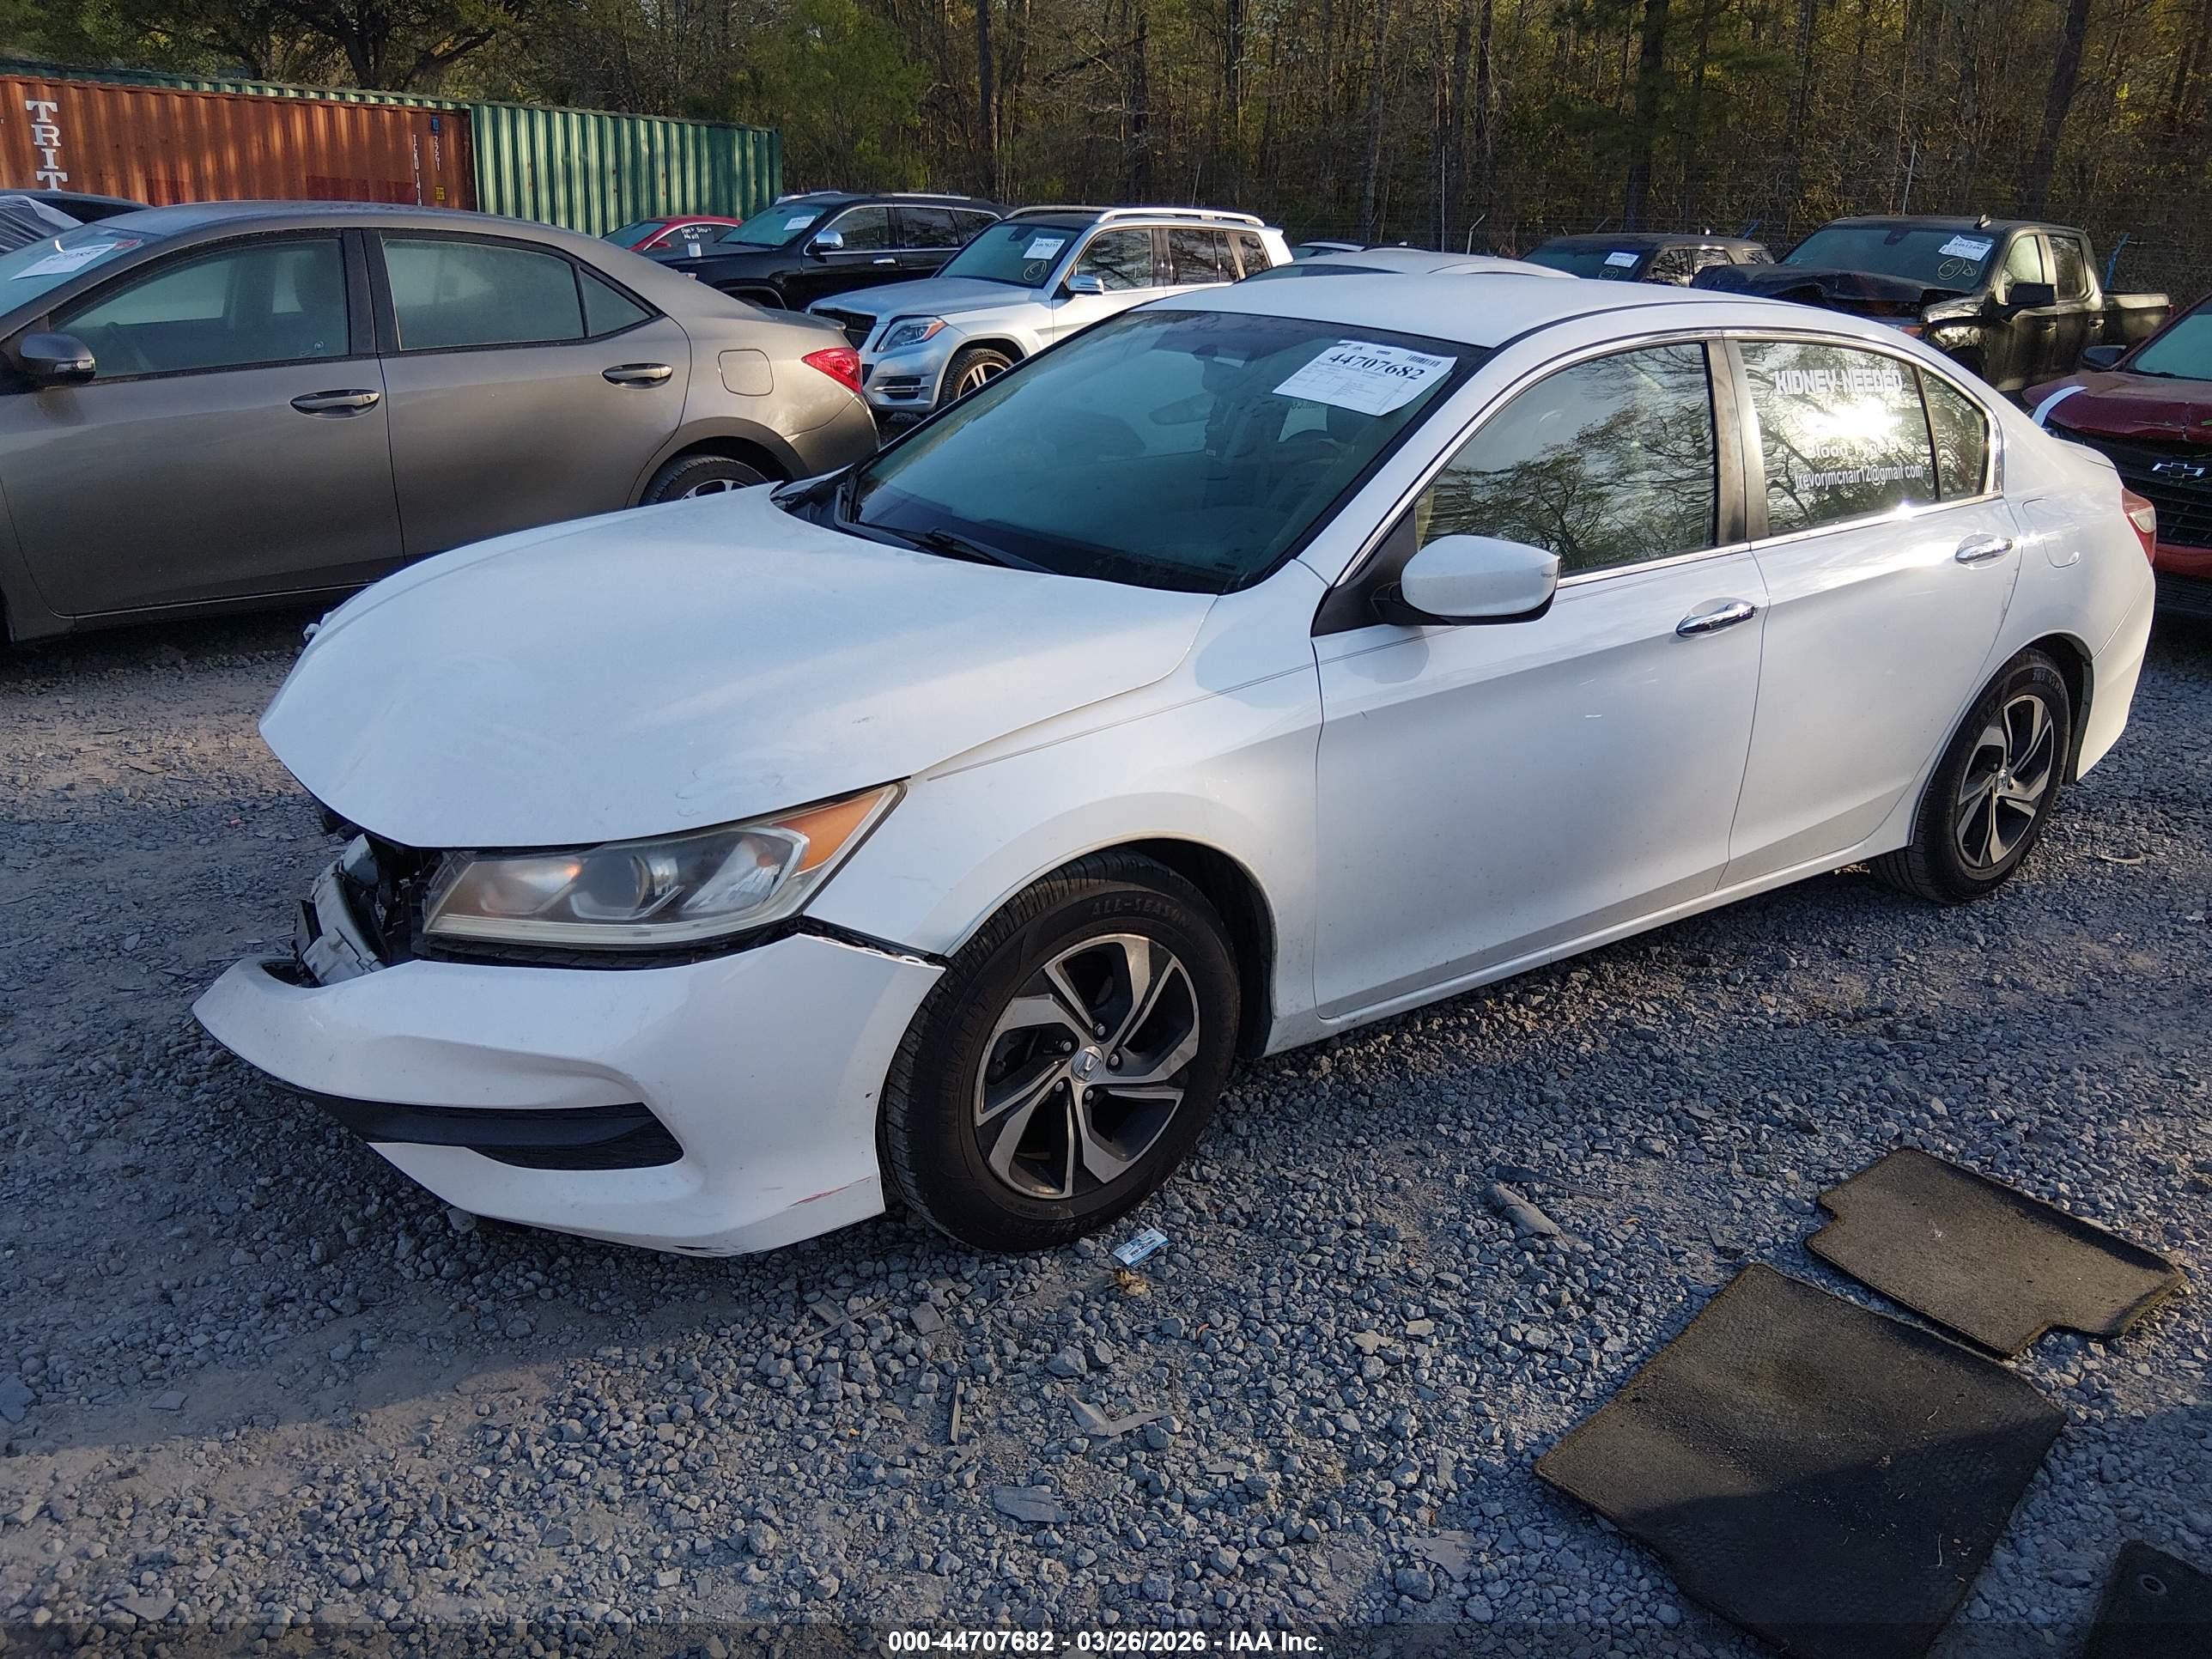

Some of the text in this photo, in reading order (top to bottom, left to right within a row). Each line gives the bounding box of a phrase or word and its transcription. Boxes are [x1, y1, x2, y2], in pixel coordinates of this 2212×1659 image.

[1328, 353, 1425, 380] 44707682
[1774, 370, 1903, 395] KIDNEY NEEDED
[1796, 463, 1923, 490] trevorjmcnair12@gmailcom
